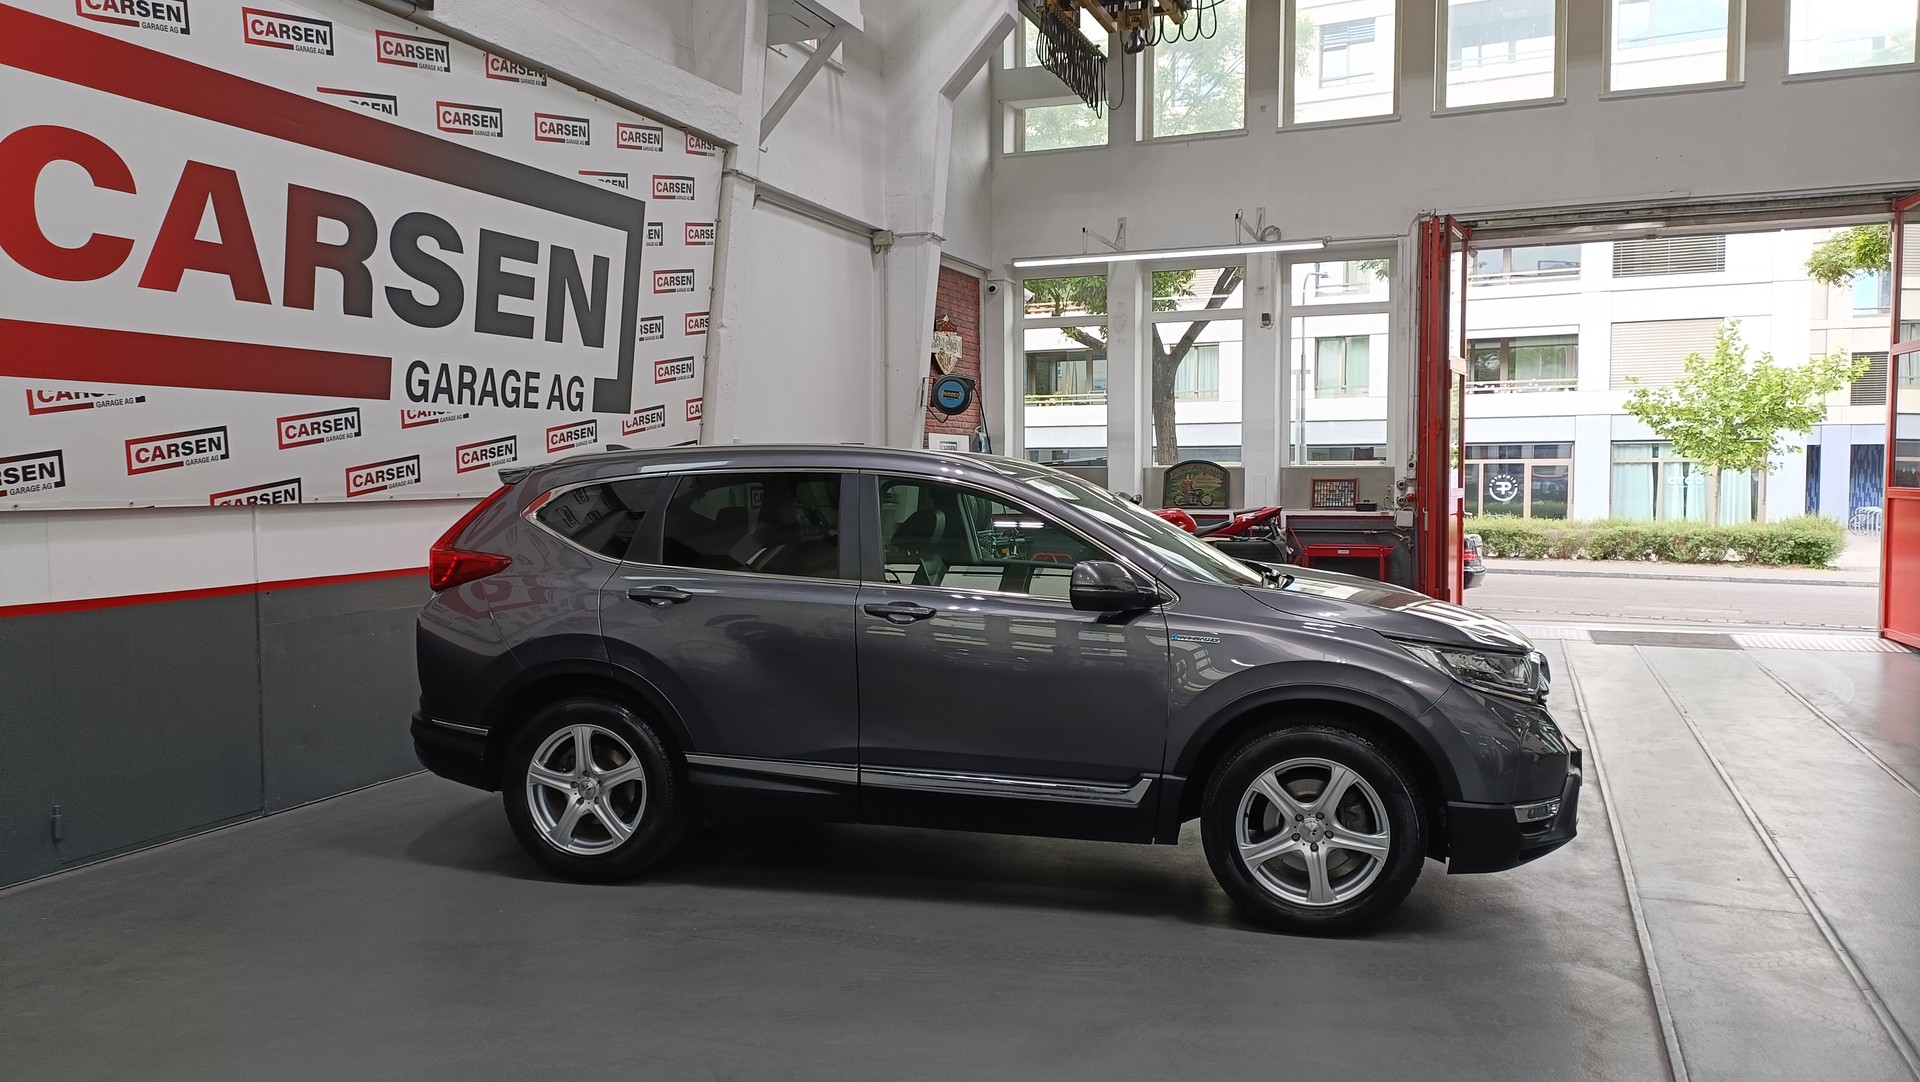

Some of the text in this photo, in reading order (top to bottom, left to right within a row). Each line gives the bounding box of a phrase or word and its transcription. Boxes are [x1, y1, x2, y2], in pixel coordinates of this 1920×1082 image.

[141, 22, 179, 34] GARAGE AG
[251, 19, 328, 45] CARSEN
[295, 45, 316, 54] GARAGE
[382, 40, 446, 63] CARSEN
[418, 62, 436, 70] GARAGE
[442, 110, 498, 129] CARSEN
[539, 121, 586, 138] CARSEN
[620, 130, 660, 145] CARSEN
[656, 182, 692, 194] CARSEN
[0, 125, 610, 348] CARSEN
[656, 276, 692, 287] CARSEN
[658, 363, 692, 378] CARSEN
[405, 360, 584, 412] GARAGE AG
[96, 397, 134, 408] GARAGE AG
[440, 414, 456, 423] GARAGE
[285, 416, 355, 440] CARSEN
[551, 426, 594, 445] CARSEN
[326, 434, 346, 442] GARAGE
[135, 436, 222, 464] CARSEN
[461, 443, 513, 464] CARSEN
[186, 457, 210, 466] GARAGE
[0, 461, 56, 486] SEN
[352, 464, 416, 488] CARSEN
[10, 483, 52, 496] GARAGE AG
[388, 480, 408, 490] GARAGE
